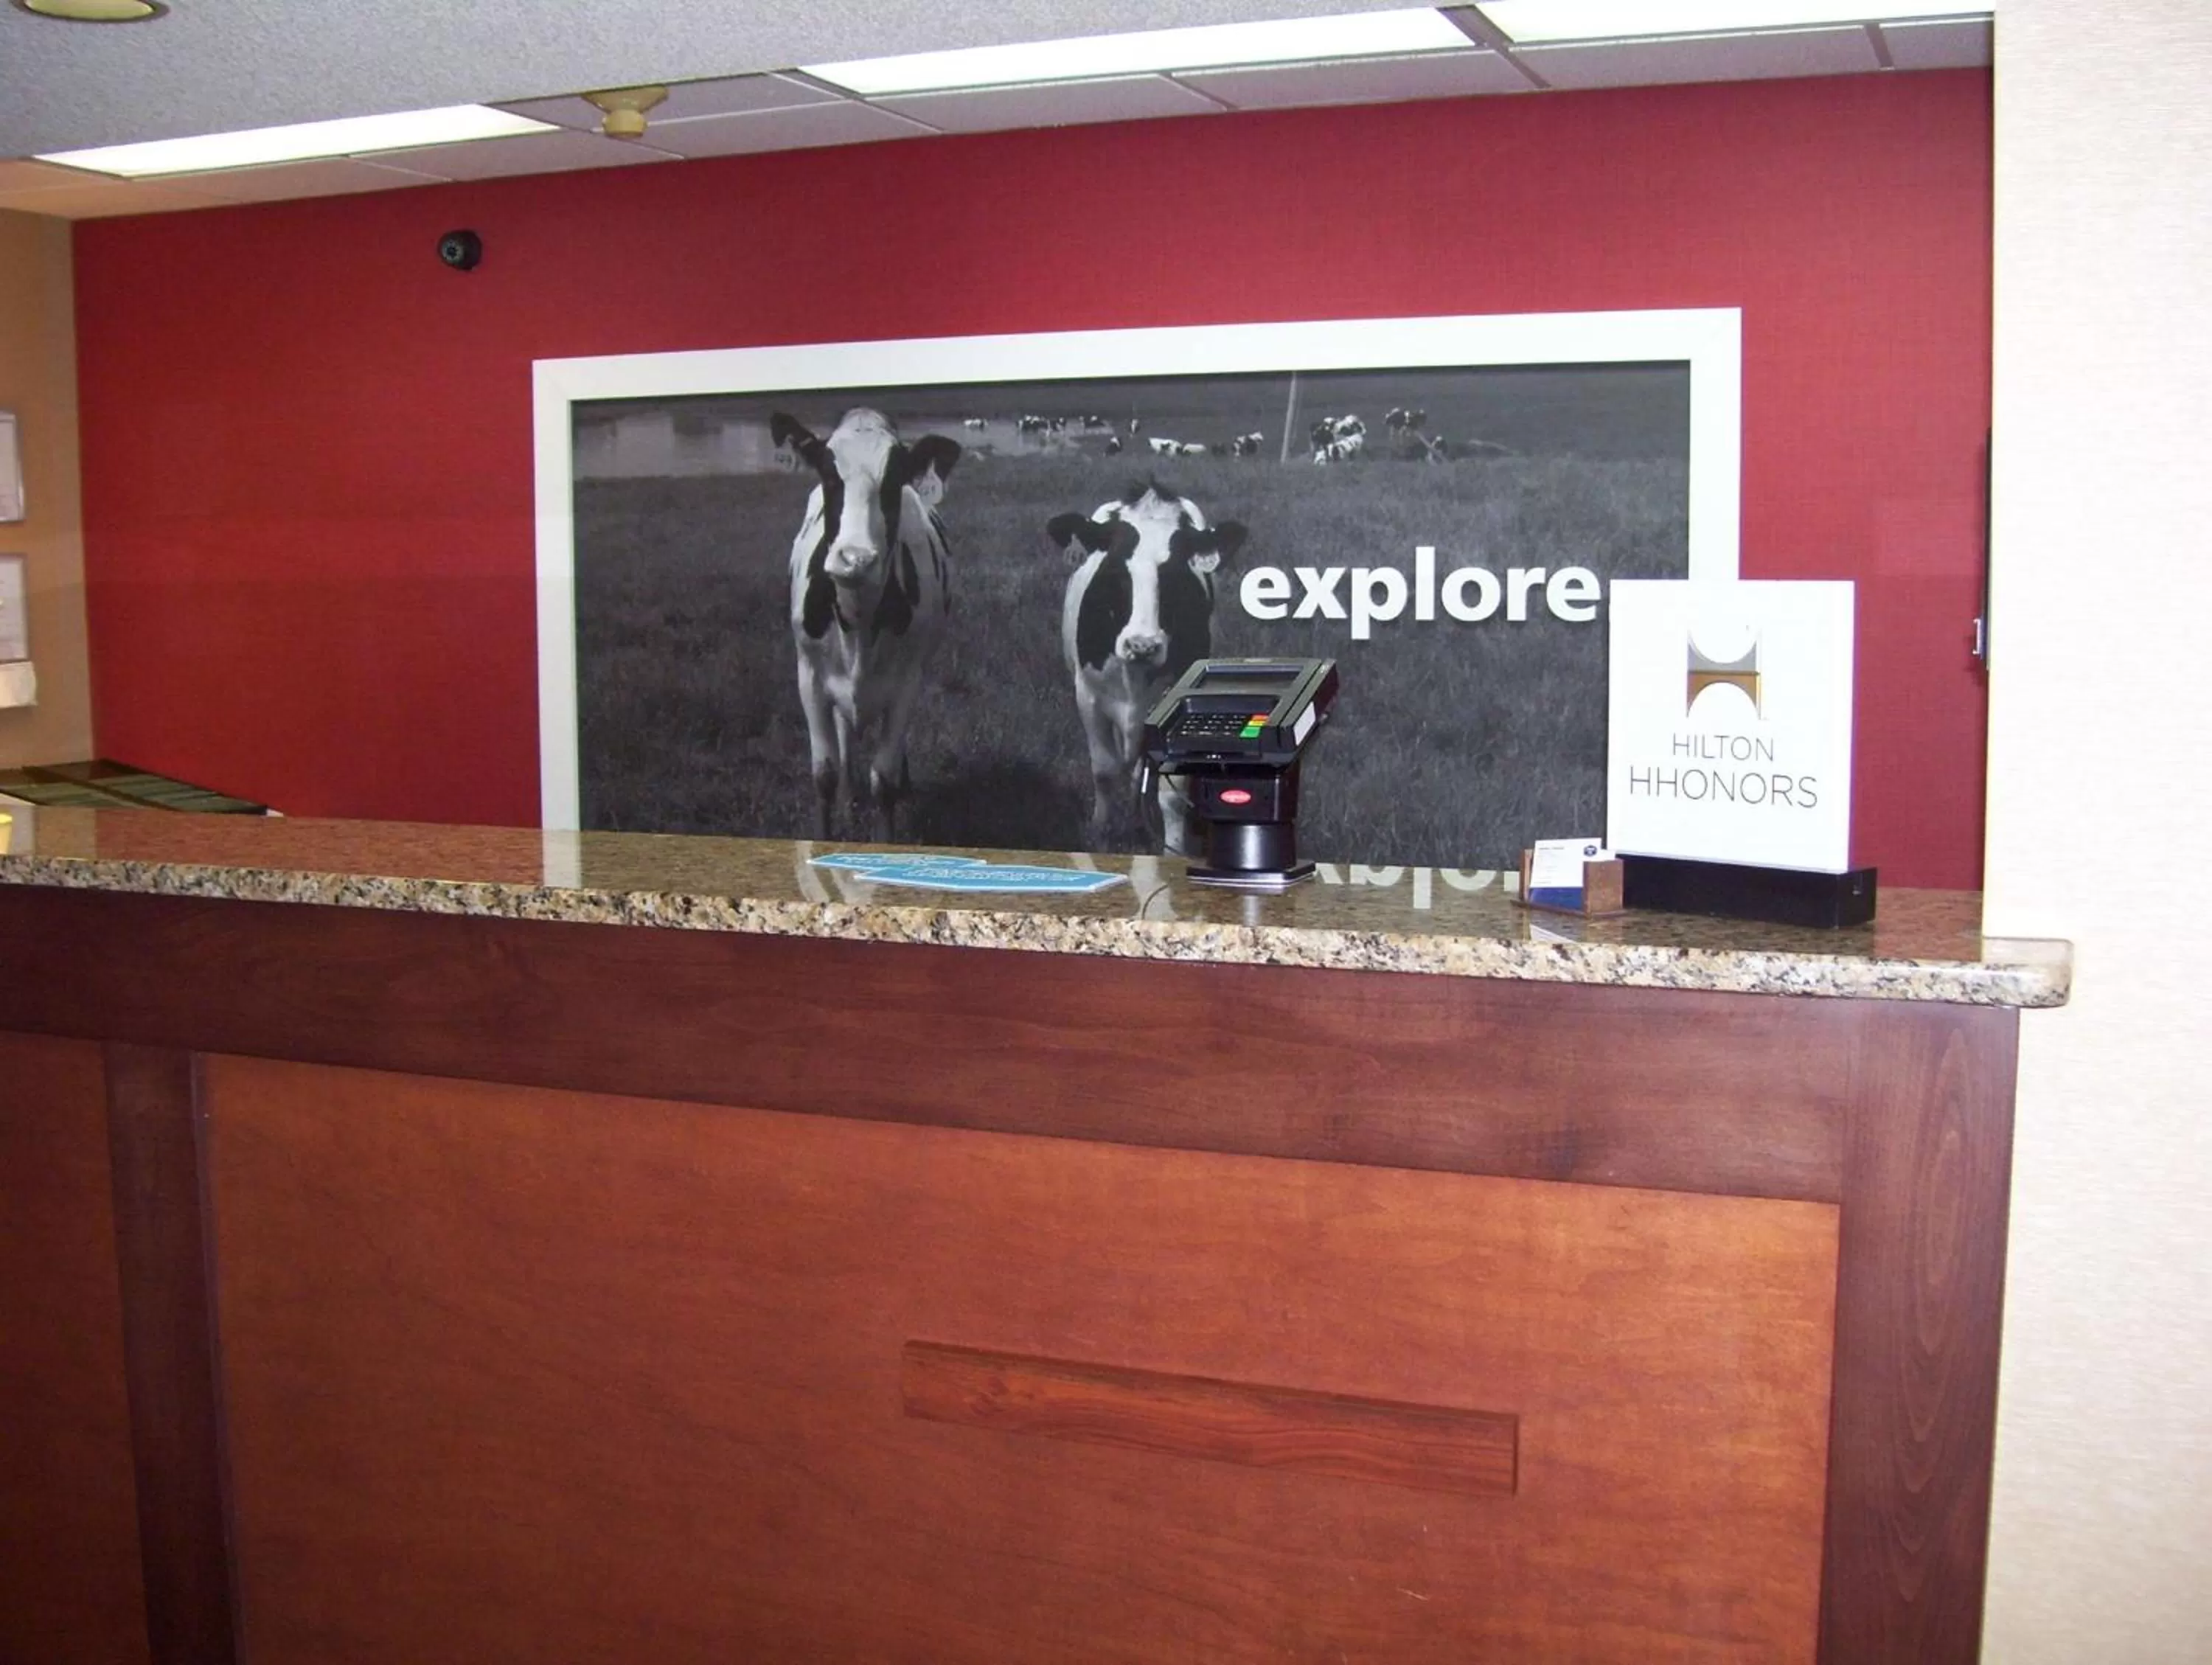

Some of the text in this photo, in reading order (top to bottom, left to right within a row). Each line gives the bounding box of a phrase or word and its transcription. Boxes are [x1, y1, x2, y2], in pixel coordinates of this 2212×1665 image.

[1239, 546, 1602, 641] explore
[1672, 732, 1774, 762] HILTON
[1630, 765, 1818, 809] HHONORS
